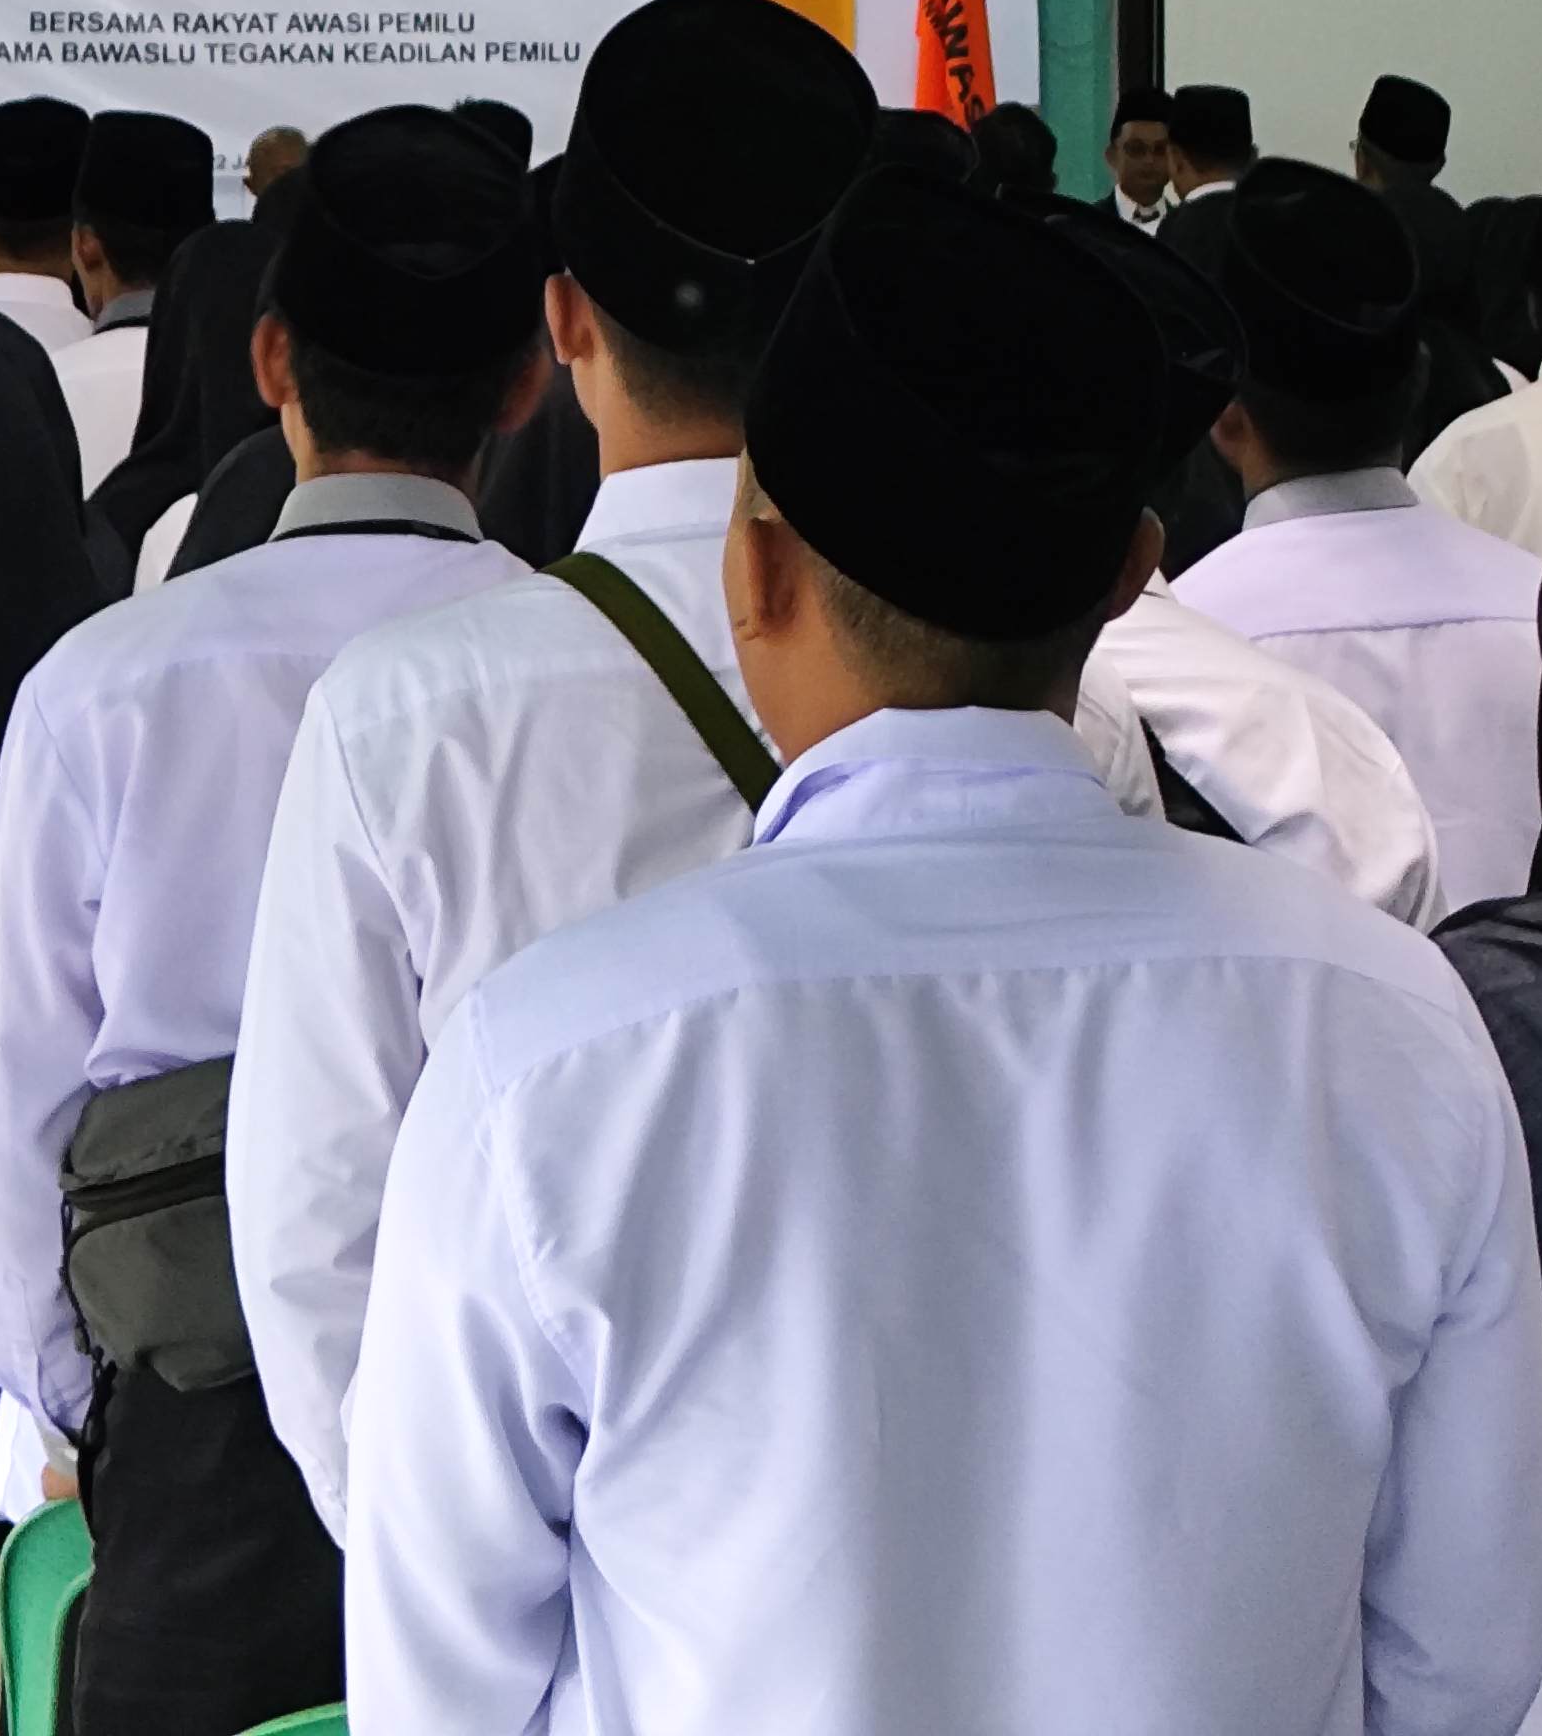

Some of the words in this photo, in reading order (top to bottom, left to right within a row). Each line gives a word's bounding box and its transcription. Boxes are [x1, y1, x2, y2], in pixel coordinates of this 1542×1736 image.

[28, 10, 165, 35] BERSAMA
[172, 11, 279, 35] RAKYAT
[286, 11, 370, 35] AWASI
[378, 11, 476, 35] PEMILU
[61, 40, 197, 65] BAWASLU
[206, 41, 335, 65] TEGAKAN
[343, 41, 477, 65] KEADILAN
[484, 40, 582, 64] PEMILU
